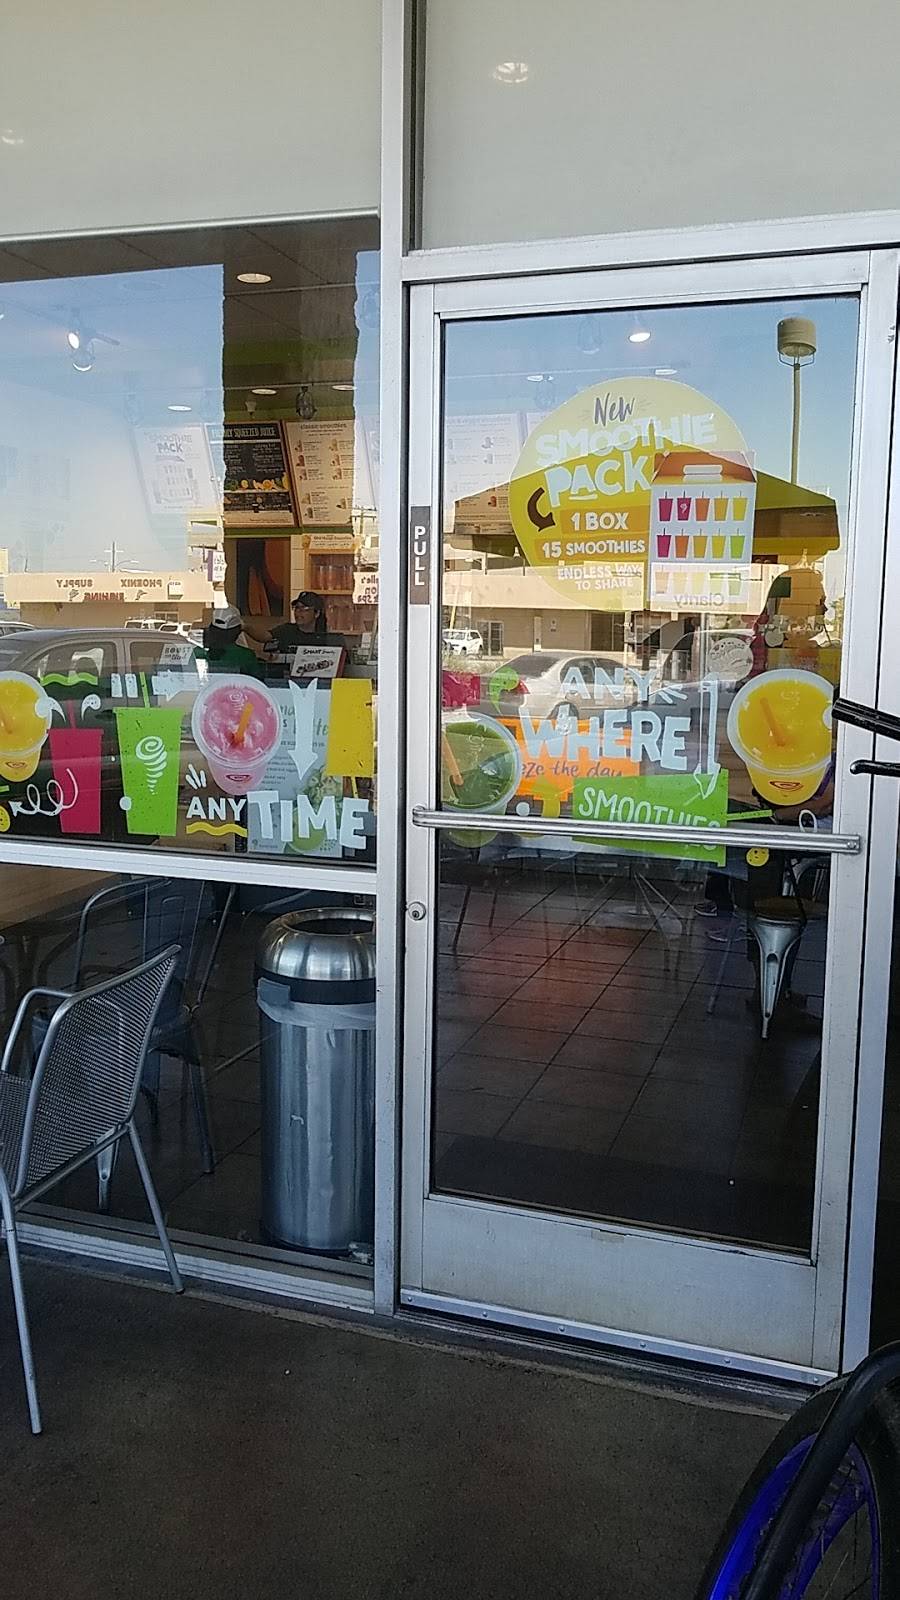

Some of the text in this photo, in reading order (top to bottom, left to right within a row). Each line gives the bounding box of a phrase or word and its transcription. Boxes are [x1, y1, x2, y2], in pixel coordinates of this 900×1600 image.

[594, 393, 635, 427] New
[157, 442, 183, 453] PACK
[536, 413, 717, 467] SMOOTHIE
[544, 451, 652, 508] PACK
[571, 512, 629, 531] 1 BOX
[413, 525, 426, 587] PULL
[542, 540, 646, 558] 15 SMOOTHIES
[557, 566, 611, 580] ENDLESS
[576, 577, 634, 590] TO SHARE
[559, 666, 657, 701] ANY
[519, 704, 691, 770] WHERE
[549, 760, 579, 777] the
[187, 790, 369, 849] ANY TIME
